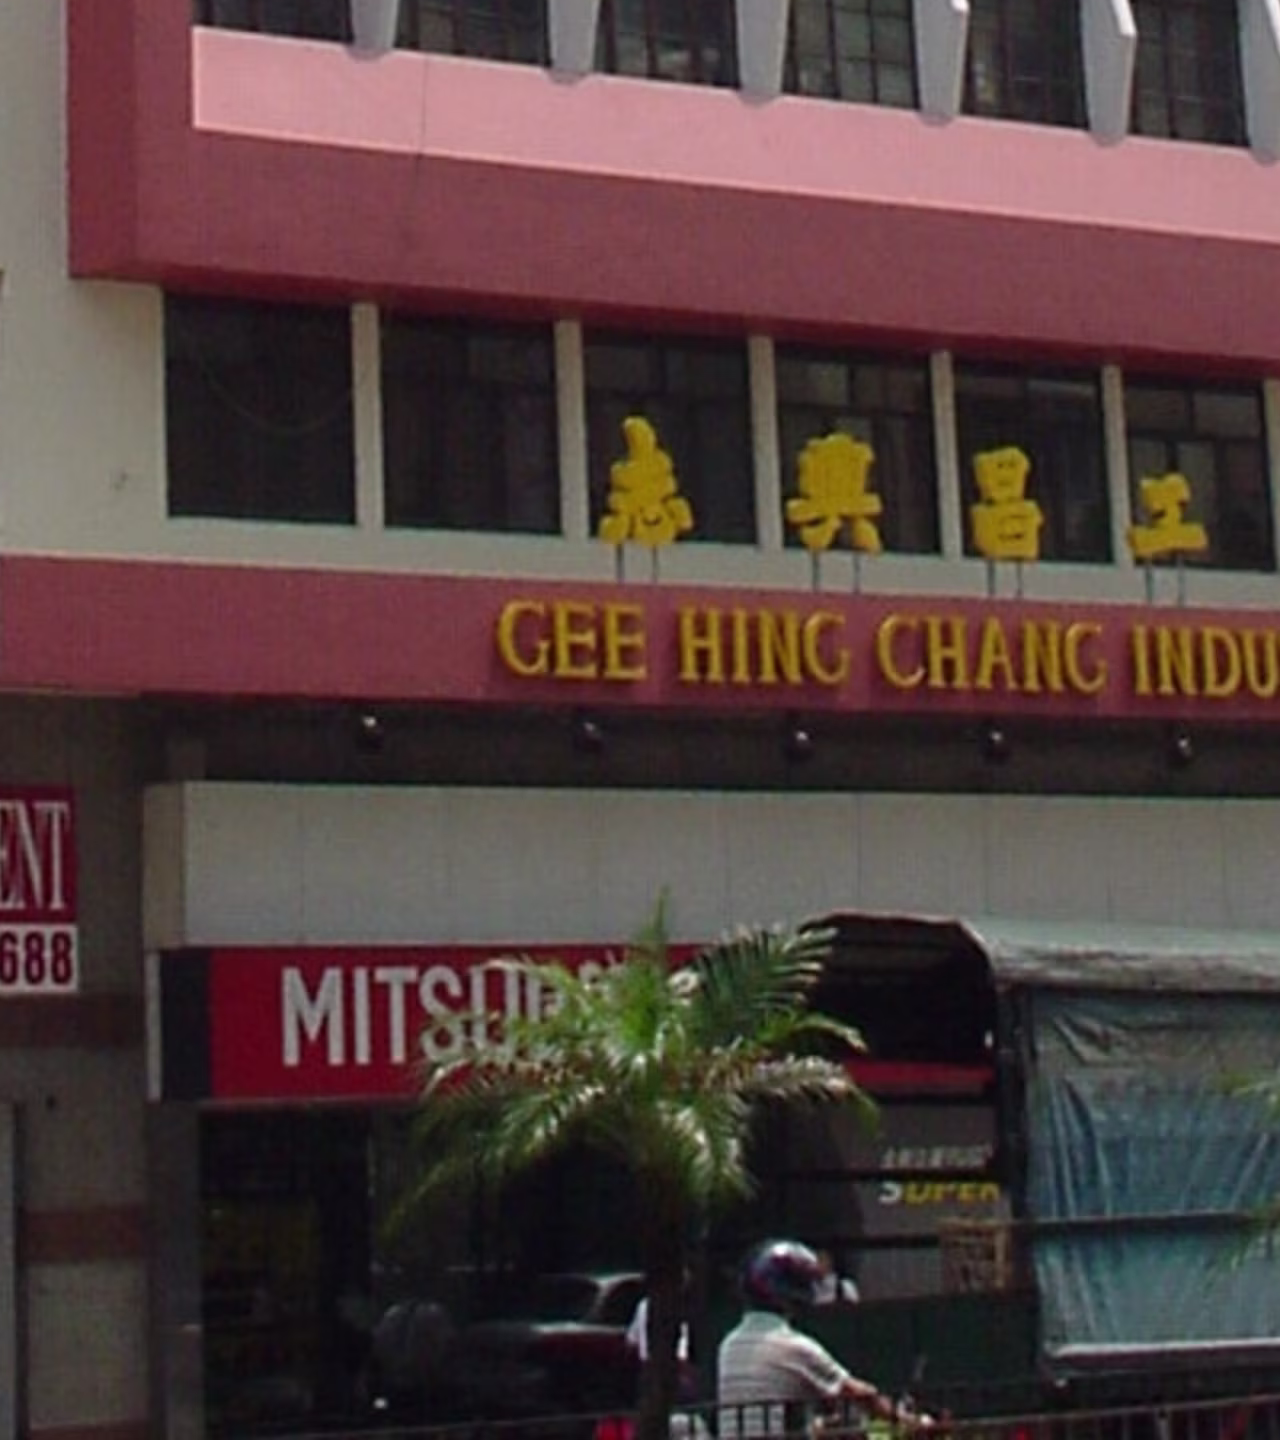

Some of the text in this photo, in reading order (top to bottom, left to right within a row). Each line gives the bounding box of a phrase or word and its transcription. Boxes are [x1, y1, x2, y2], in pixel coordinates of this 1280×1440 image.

[497, 599, 647, 680] GEE
[679, 605, 851, 686] HING
[875, 614, 1108, 694] CHANG
